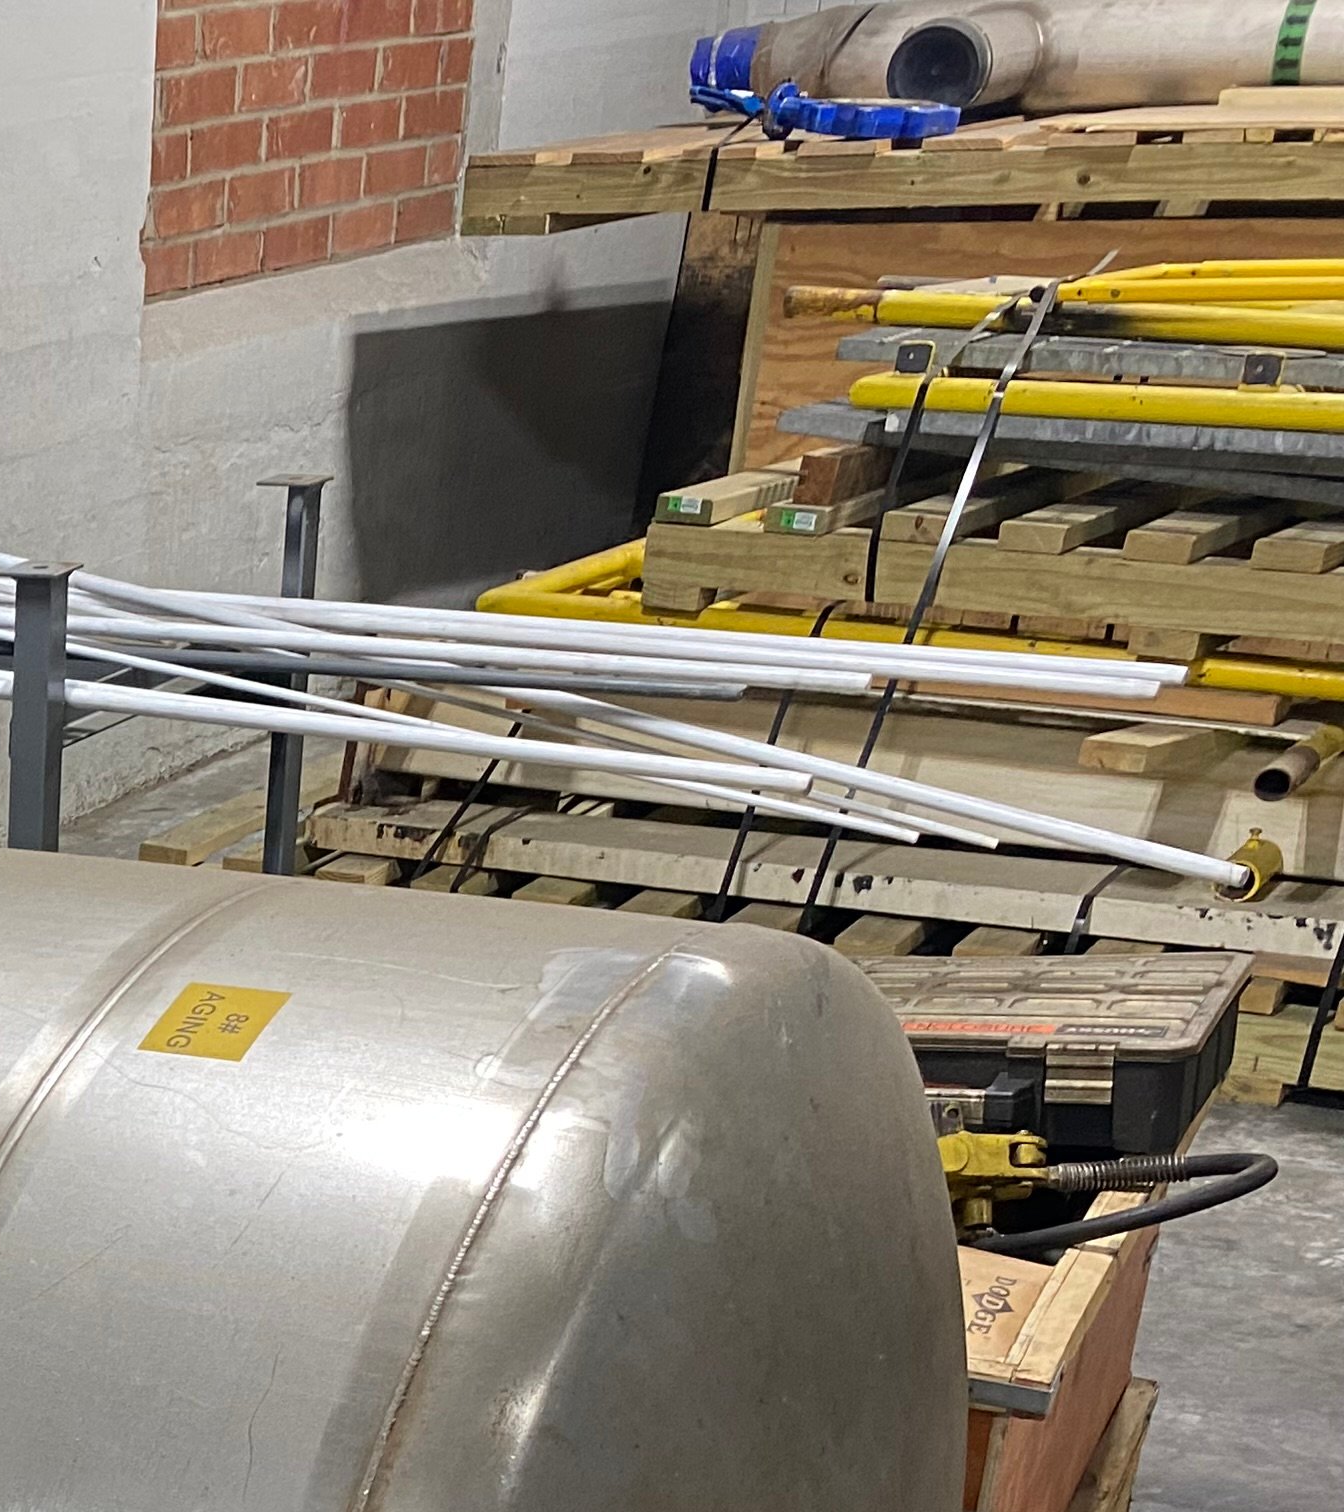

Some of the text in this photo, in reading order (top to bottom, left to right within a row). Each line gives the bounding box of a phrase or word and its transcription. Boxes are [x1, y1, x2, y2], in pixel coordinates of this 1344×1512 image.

[166, 990, 226, 1049] AGING
[217, 1012, 250, 1035] 8#
[967, 1276, 1017, 1334] DODGE
